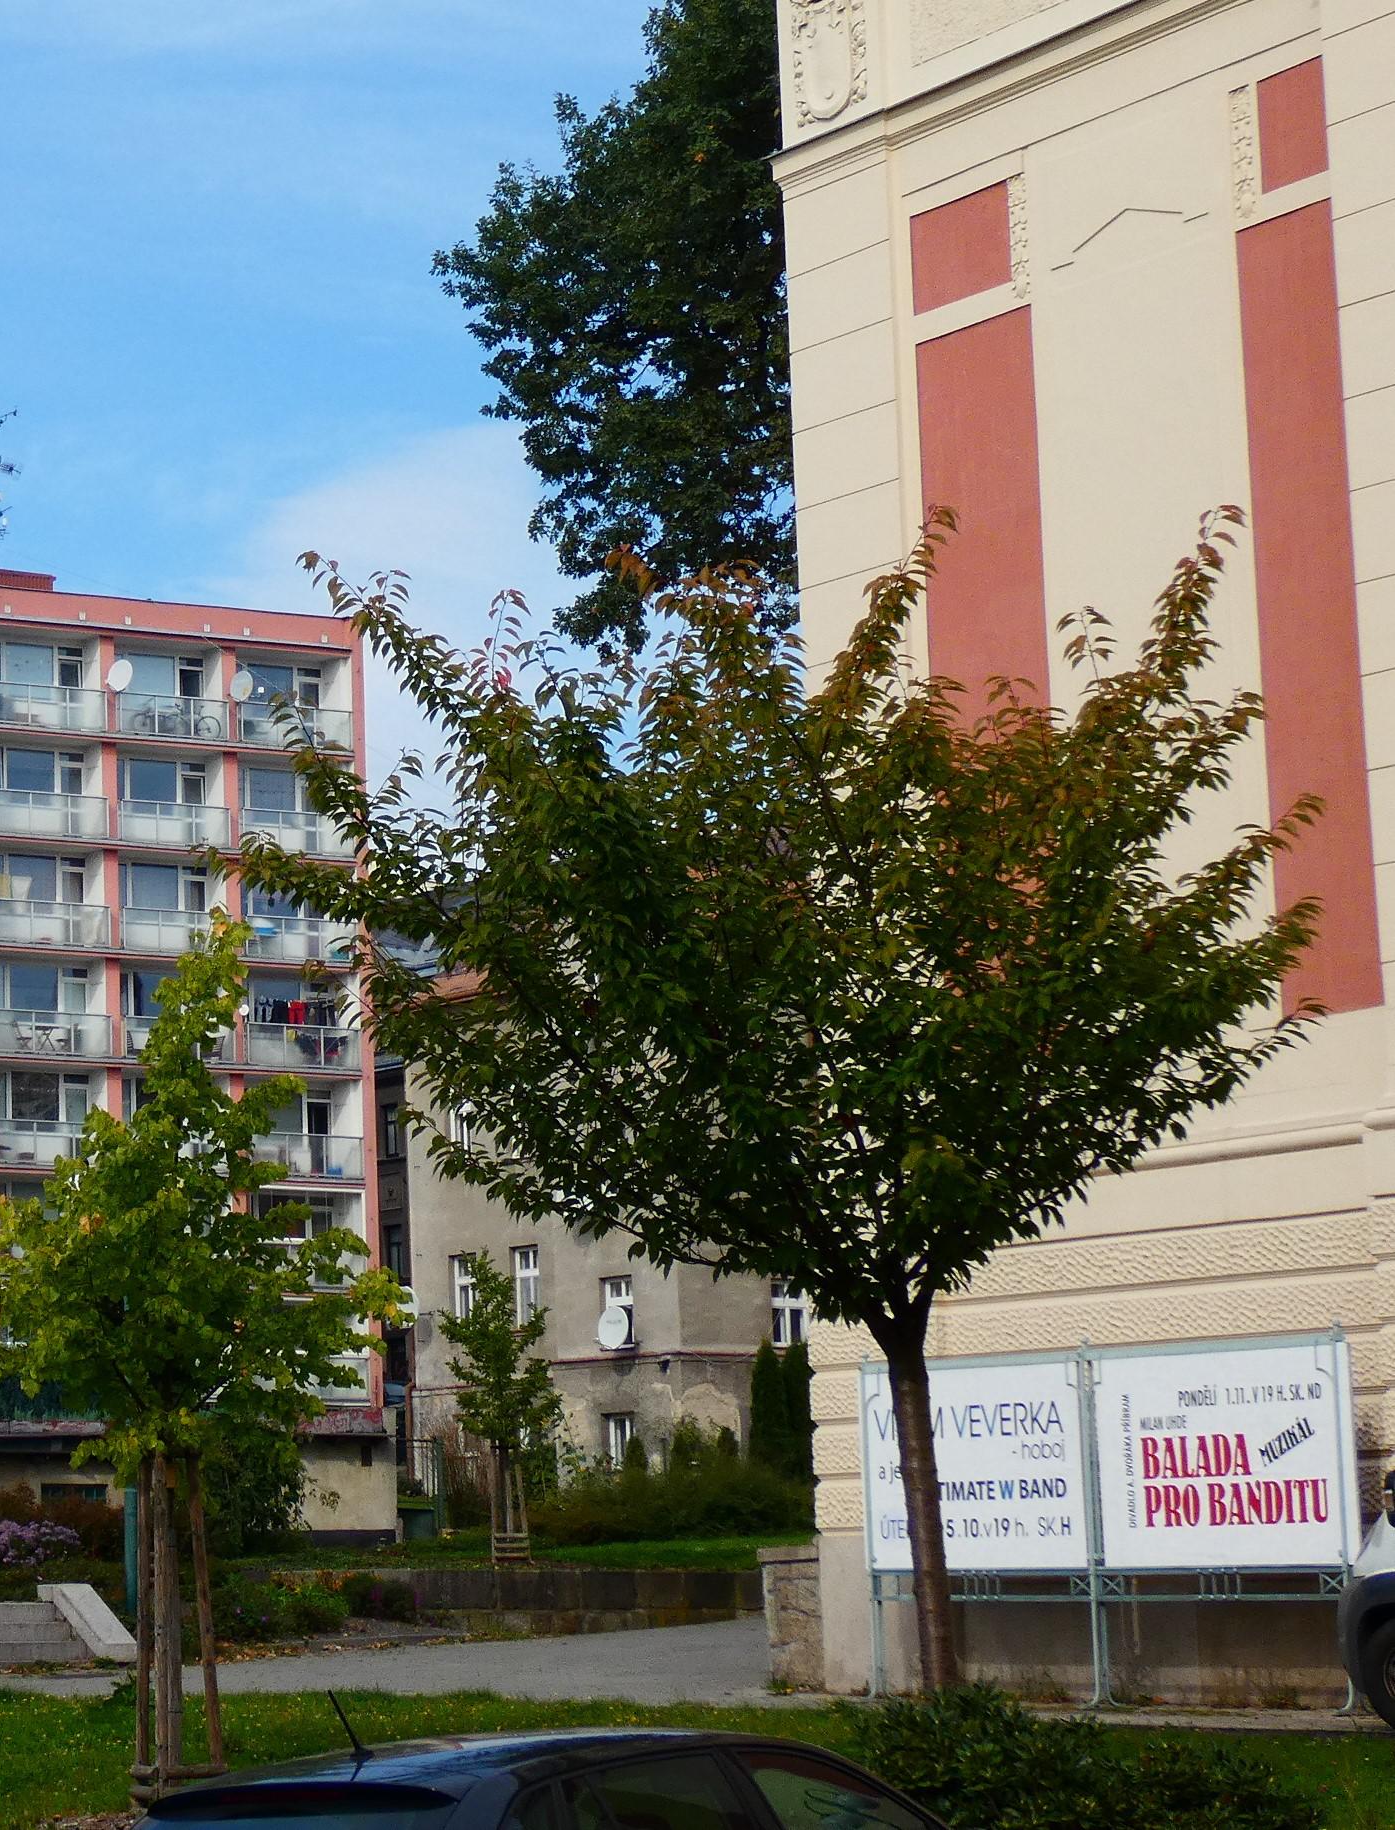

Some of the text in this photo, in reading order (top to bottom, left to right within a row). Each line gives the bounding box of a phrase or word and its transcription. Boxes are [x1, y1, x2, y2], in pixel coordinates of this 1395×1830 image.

[1178, 1384, 1218, 1408] PONDĚLÍ
[1307, 1382, 1322, 1400] ND
[950, 1401, 1064, 1438] VEVERKA
[1021, 1439, 1065, 1461] hoboj
[1140, 1433, 1253, 1480] BALADA
[1257, 1417, 1315, 1467] MUZIKÁL
[999, 1479, 1015, 1500] W
[1019, 1478, 1068, 1498] BAND
[1143, 1478, 1330, 1528] PRO BANDITU
